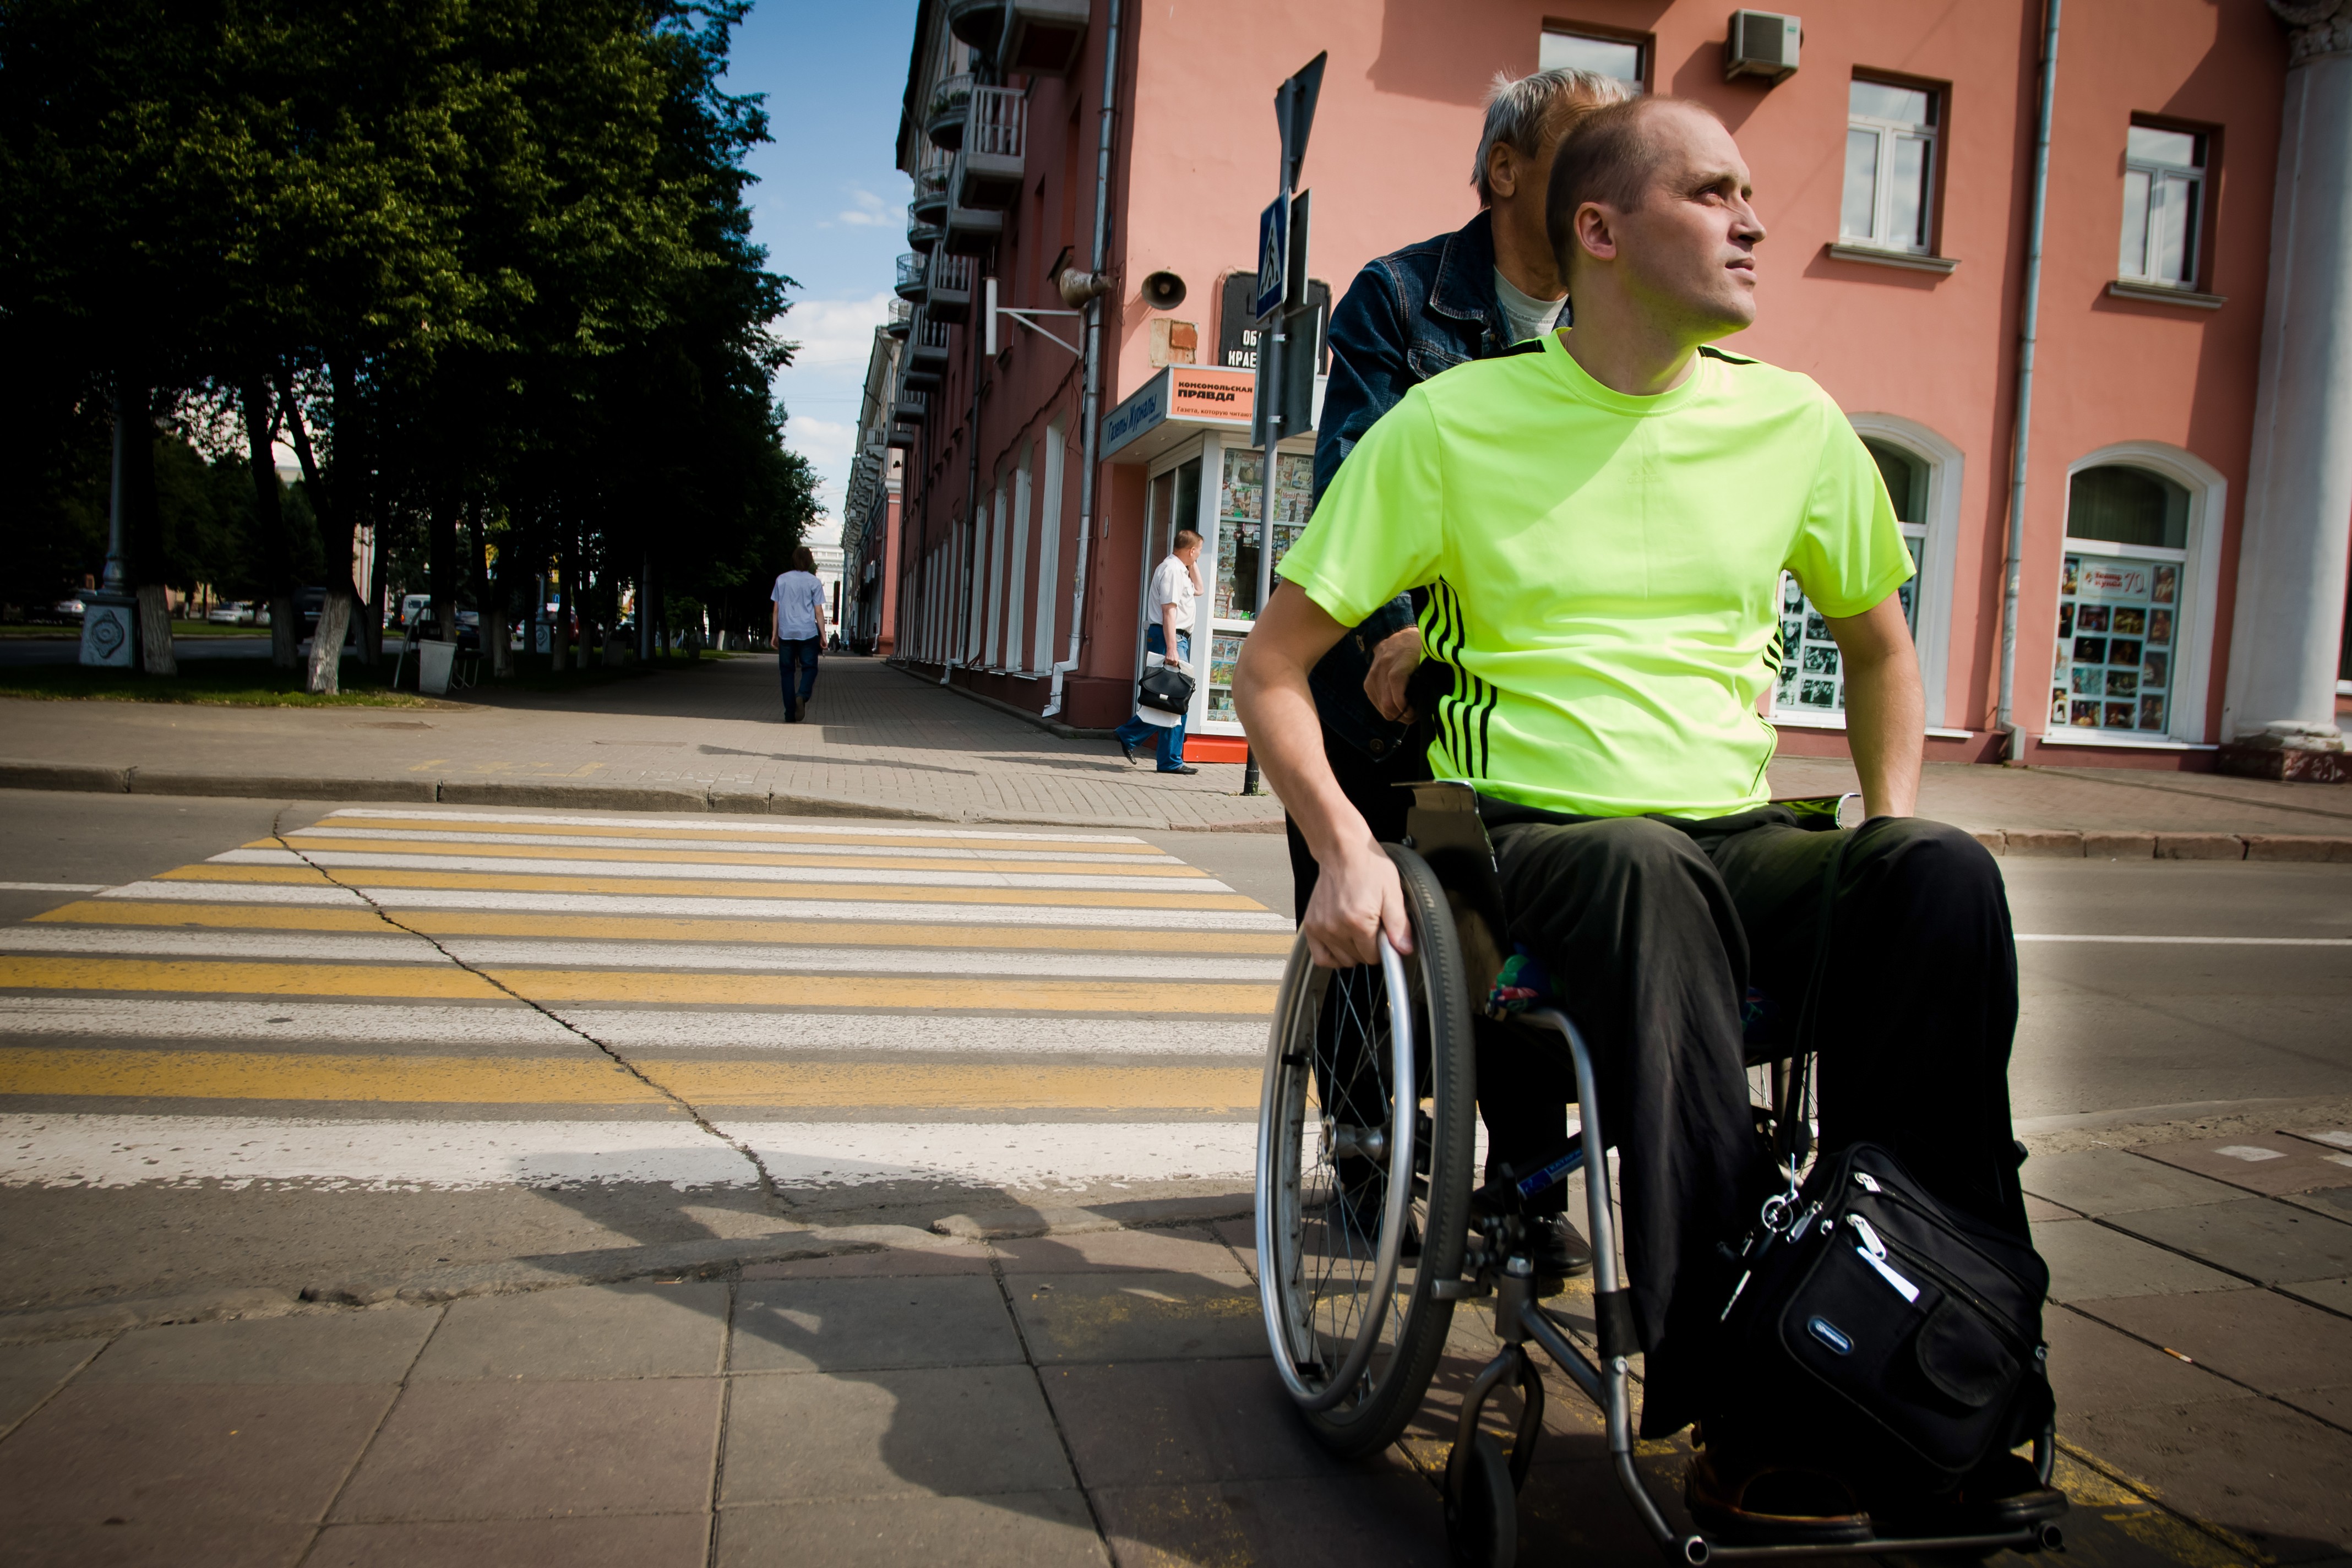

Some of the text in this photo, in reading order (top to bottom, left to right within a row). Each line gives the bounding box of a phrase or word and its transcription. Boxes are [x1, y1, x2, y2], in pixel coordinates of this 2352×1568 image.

[1179, 382, 1253, 393] КОМСОМОЛЬСКАЯ
[1178, 389, 1235, 401] ПРАВДА
[1107, 393, 1157, 444] Газеты Журналы
